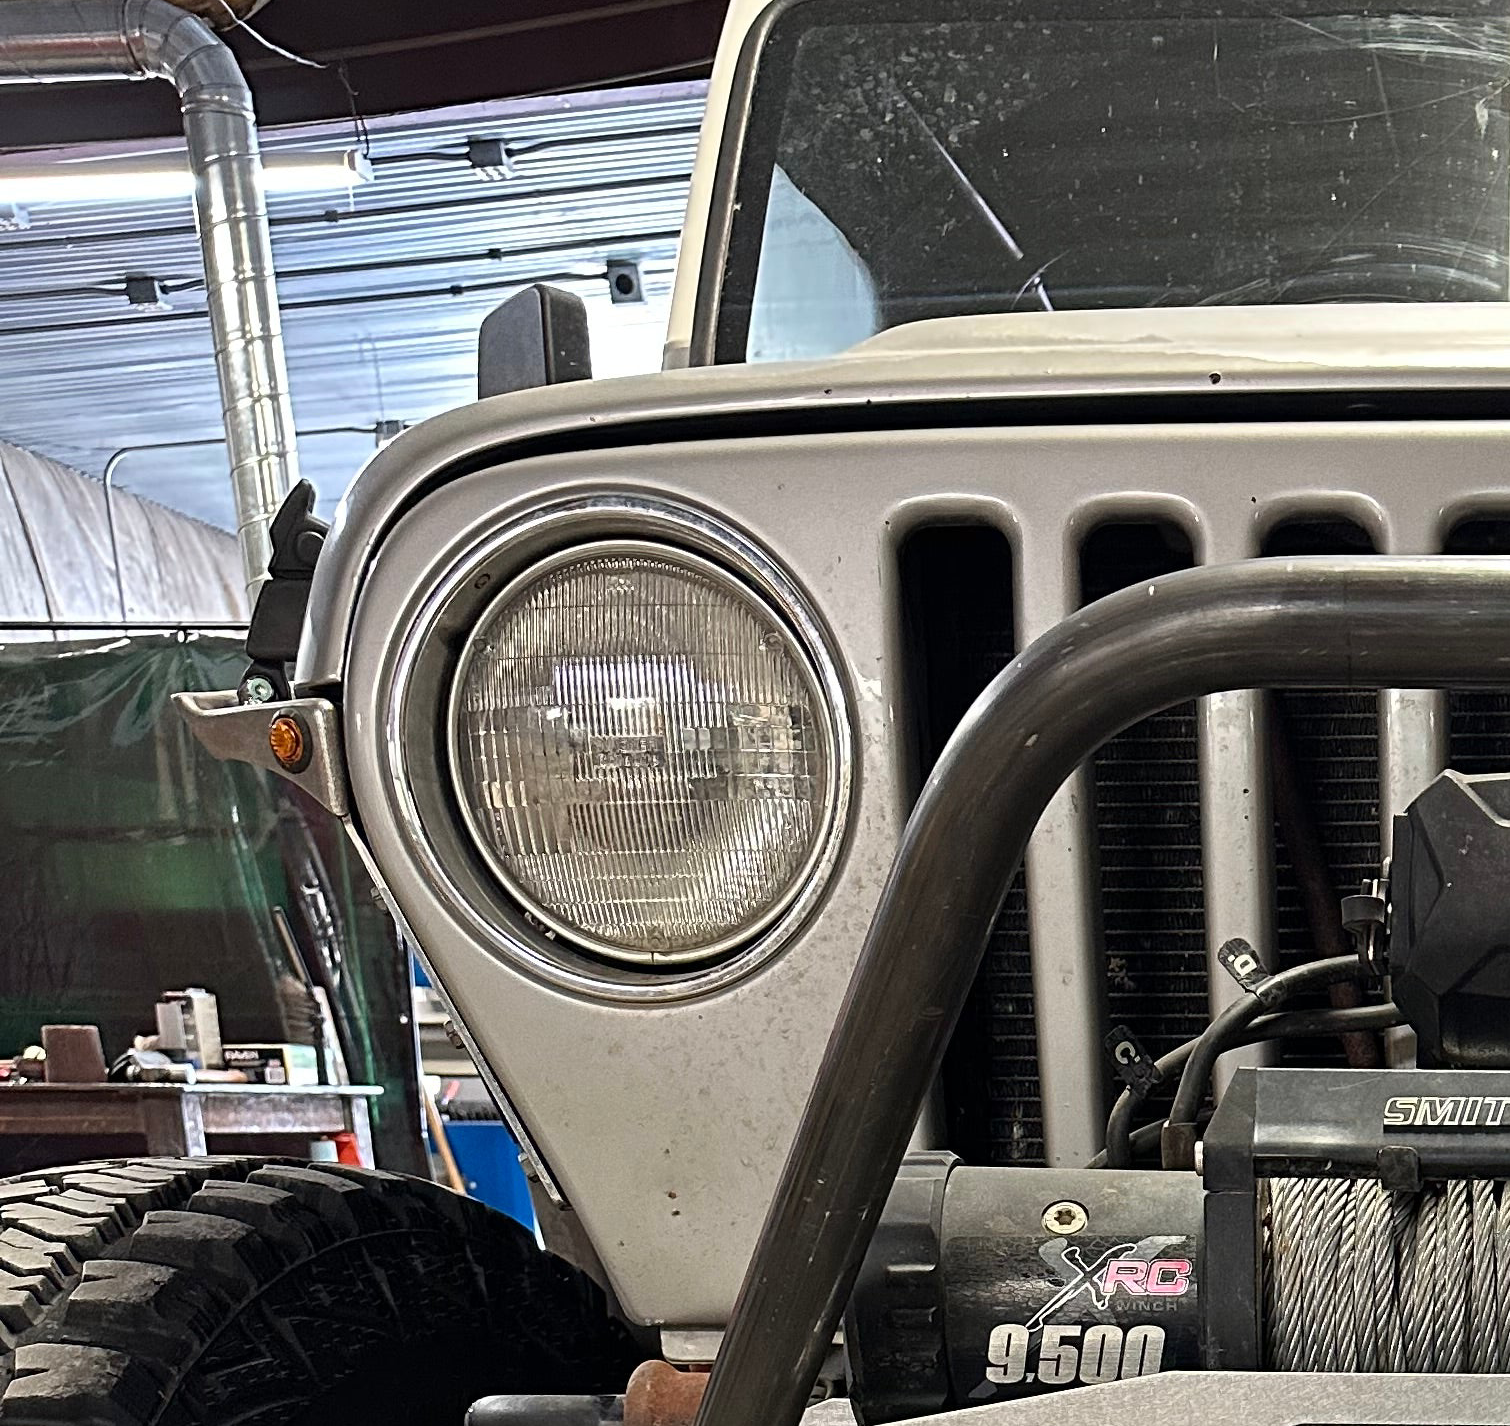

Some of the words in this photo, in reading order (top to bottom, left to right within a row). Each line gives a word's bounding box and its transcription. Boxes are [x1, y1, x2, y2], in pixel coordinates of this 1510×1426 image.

[1026, 1243, 1192, 1333] XRC
[1115, 1301, 1178, 1312] WINCH
[986, 1323, 1166, 1384] 9,500
